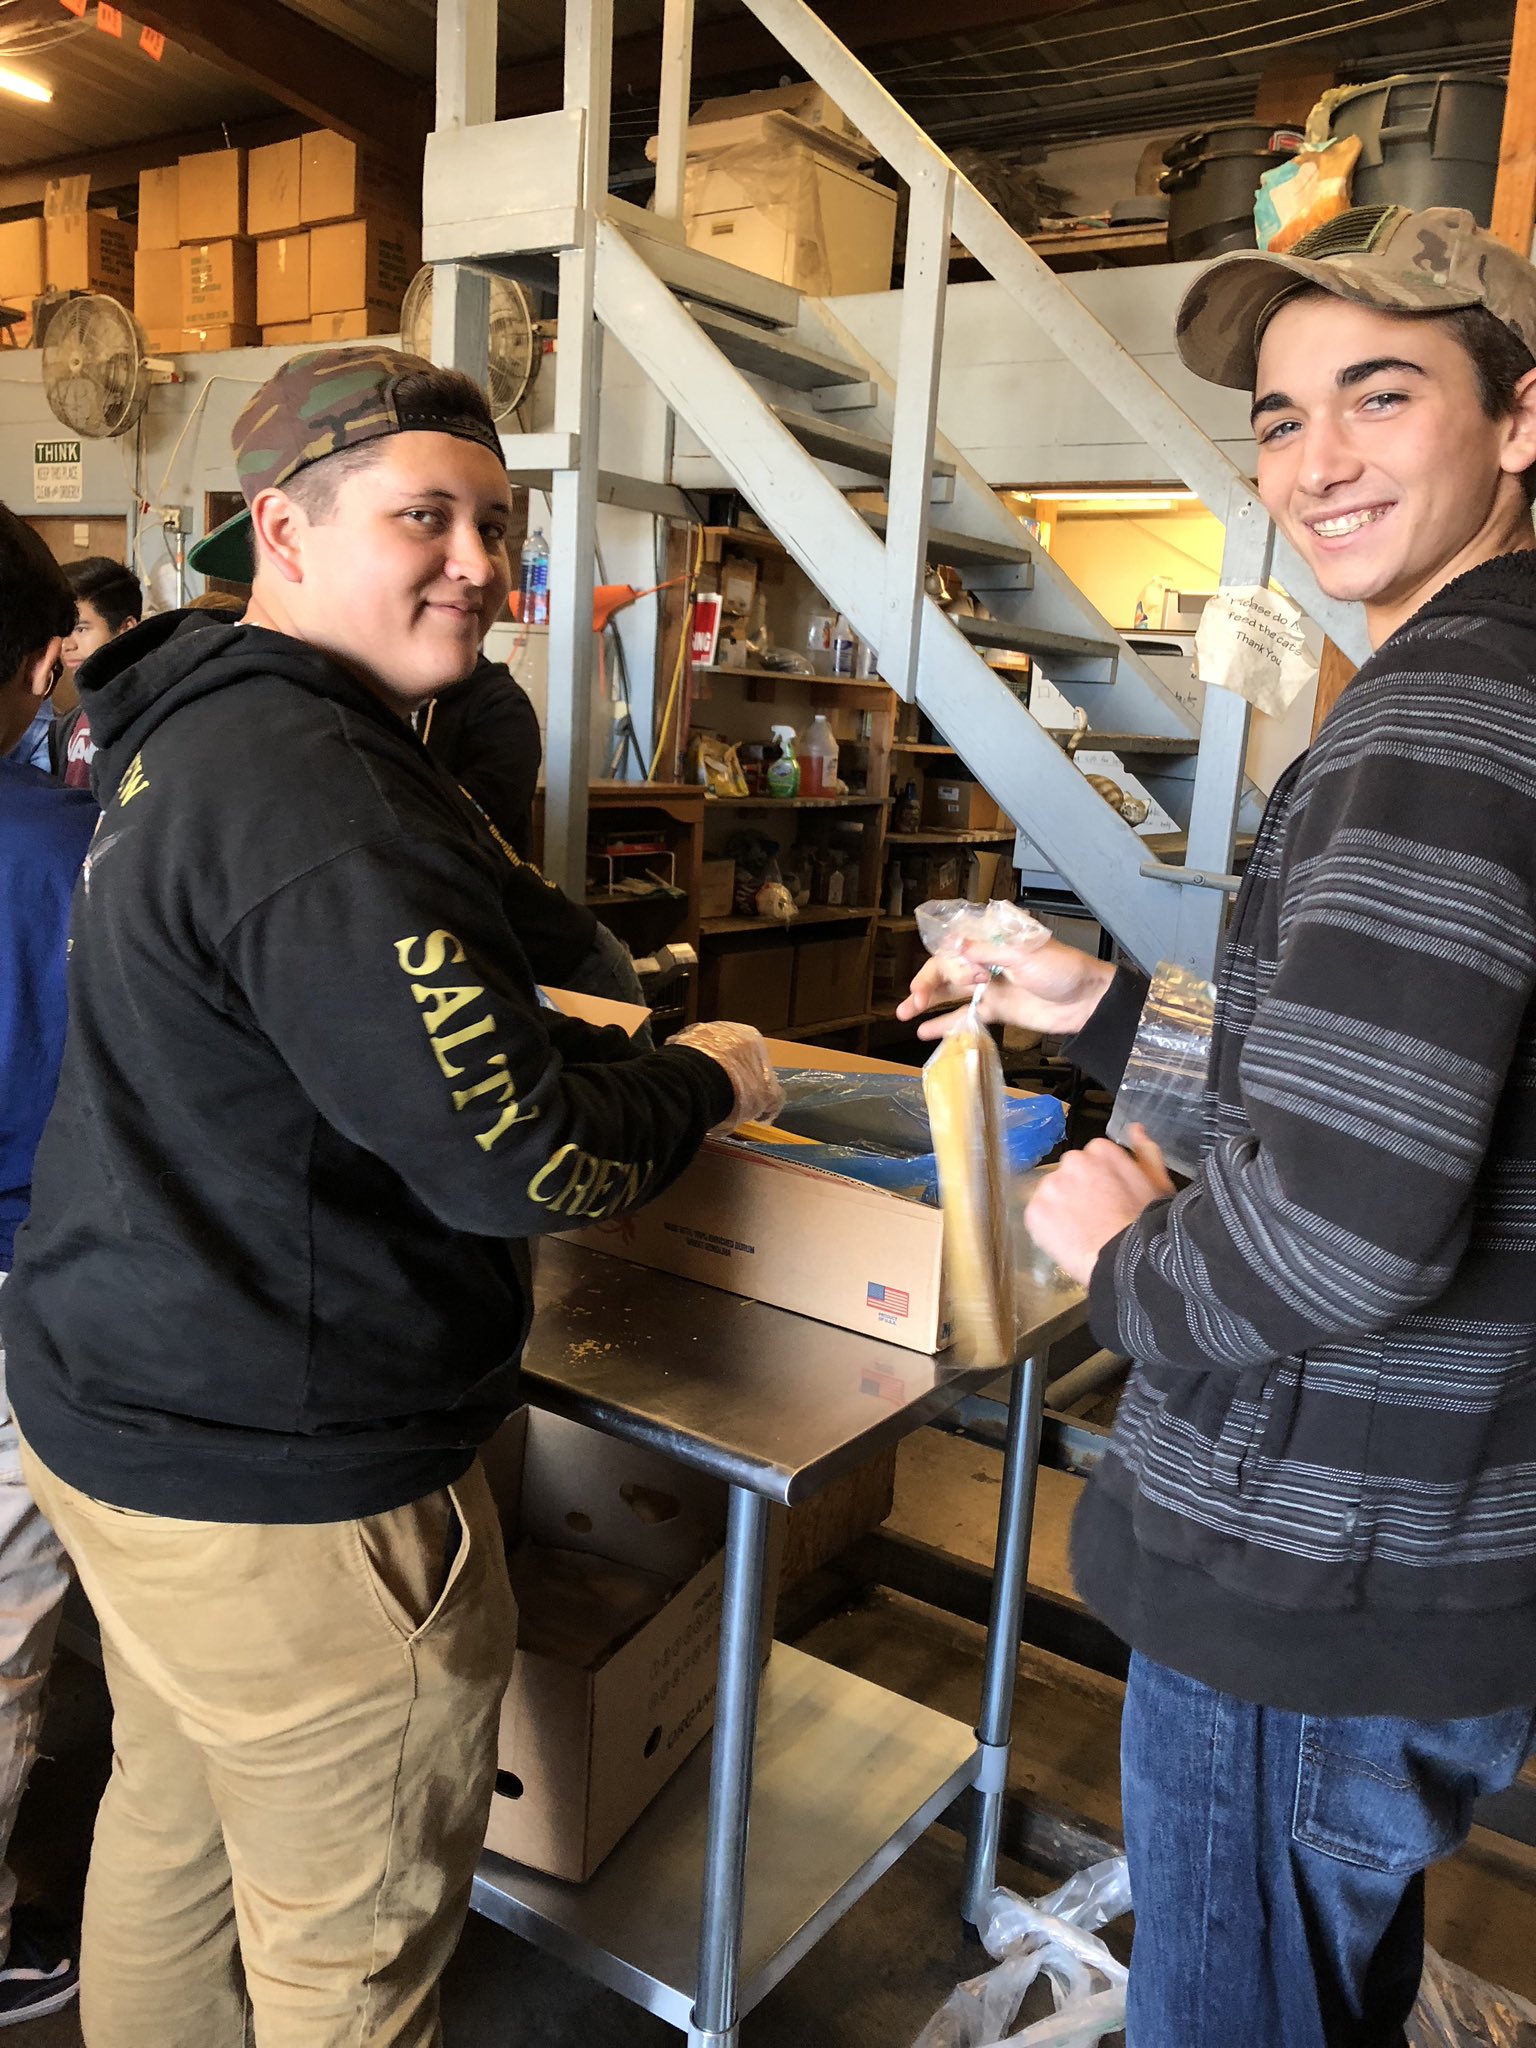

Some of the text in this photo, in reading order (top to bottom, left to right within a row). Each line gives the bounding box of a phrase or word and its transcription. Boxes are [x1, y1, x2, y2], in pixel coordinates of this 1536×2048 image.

[37, 443, 78, 462] THINK
[1228, 611, 1257, 628] feed
[1258, 623, 1277, 639] the
[1276, 636, 1303, 656] cats
[1272, 612, 1288, 625] do
[1236, 630, 1282, 666] Thank You
[393, 929, 540, 1152] SALTY
